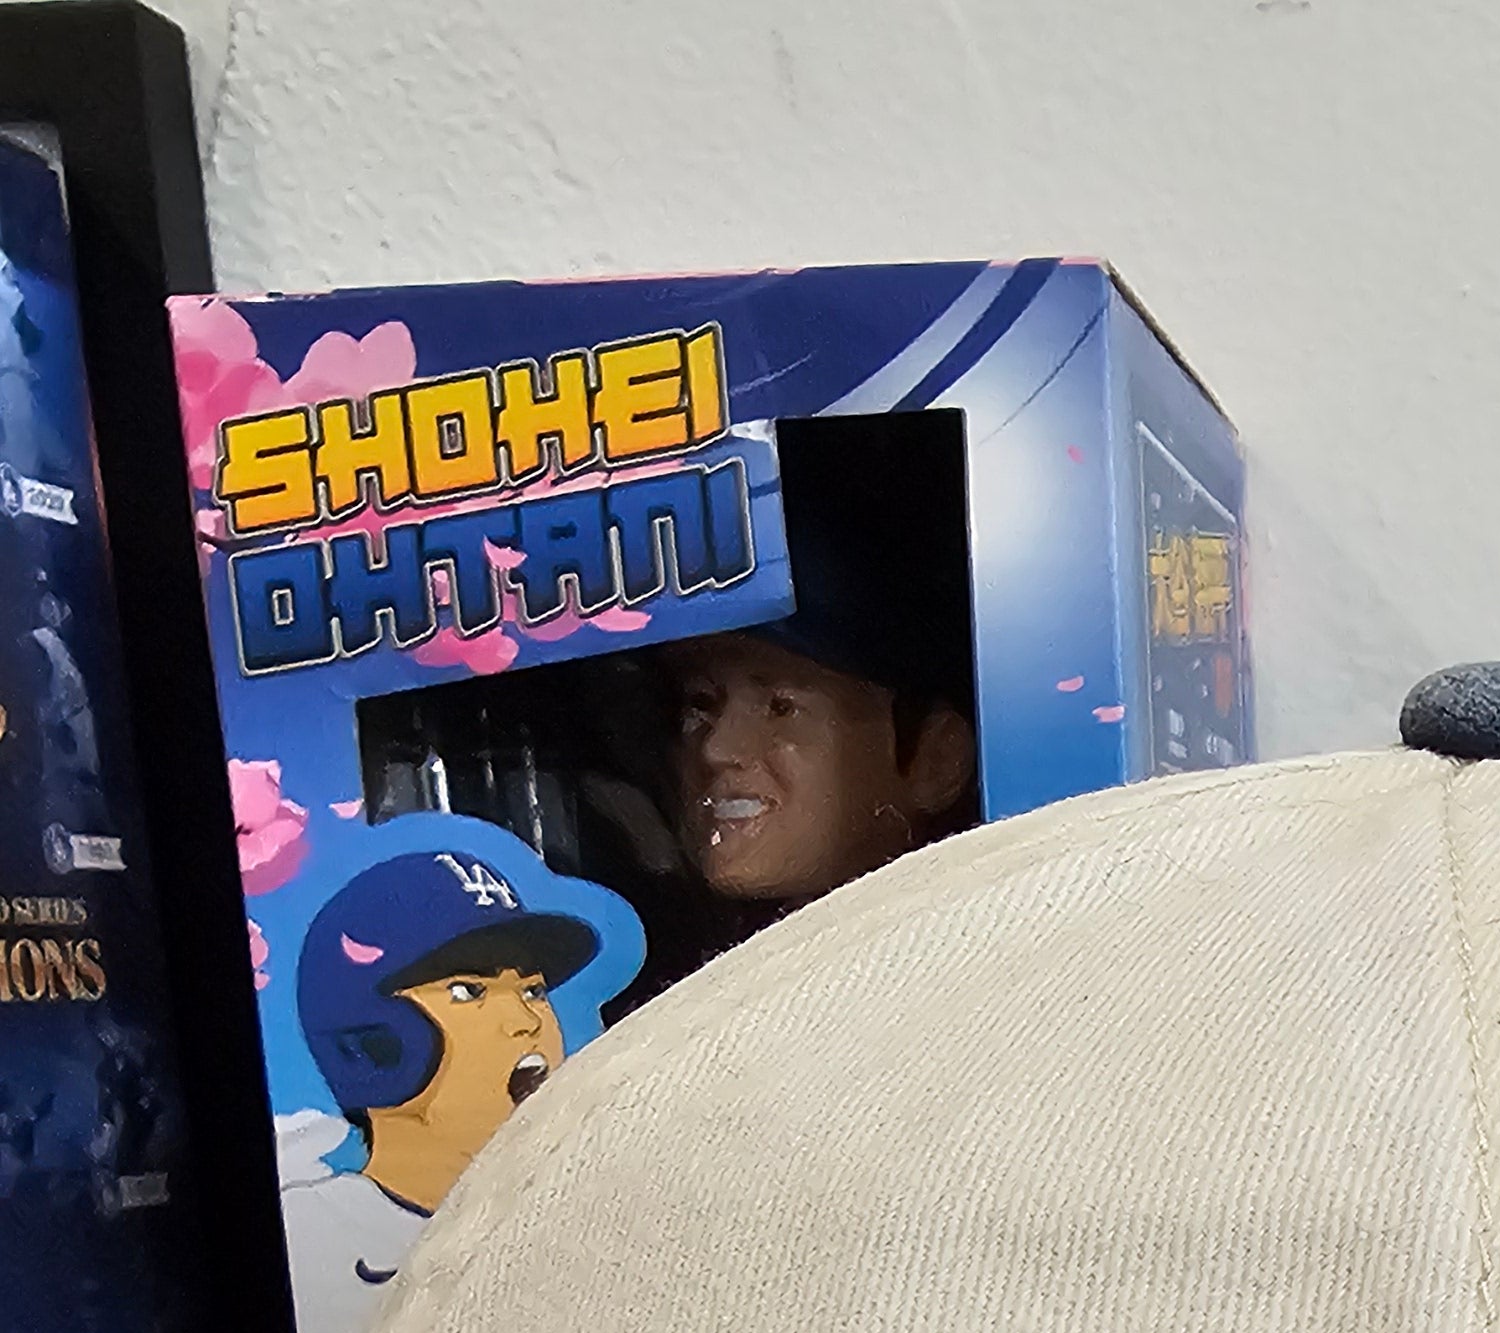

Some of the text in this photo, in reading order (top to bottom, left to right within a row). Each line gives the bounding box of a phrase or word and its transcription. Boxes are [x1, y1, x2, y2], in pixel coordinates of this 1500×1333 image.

[214, 321, 730, 537] SHOHEI
[229, 457, 756, 675] OHTANI
[434, 853, 518, 910] LA
